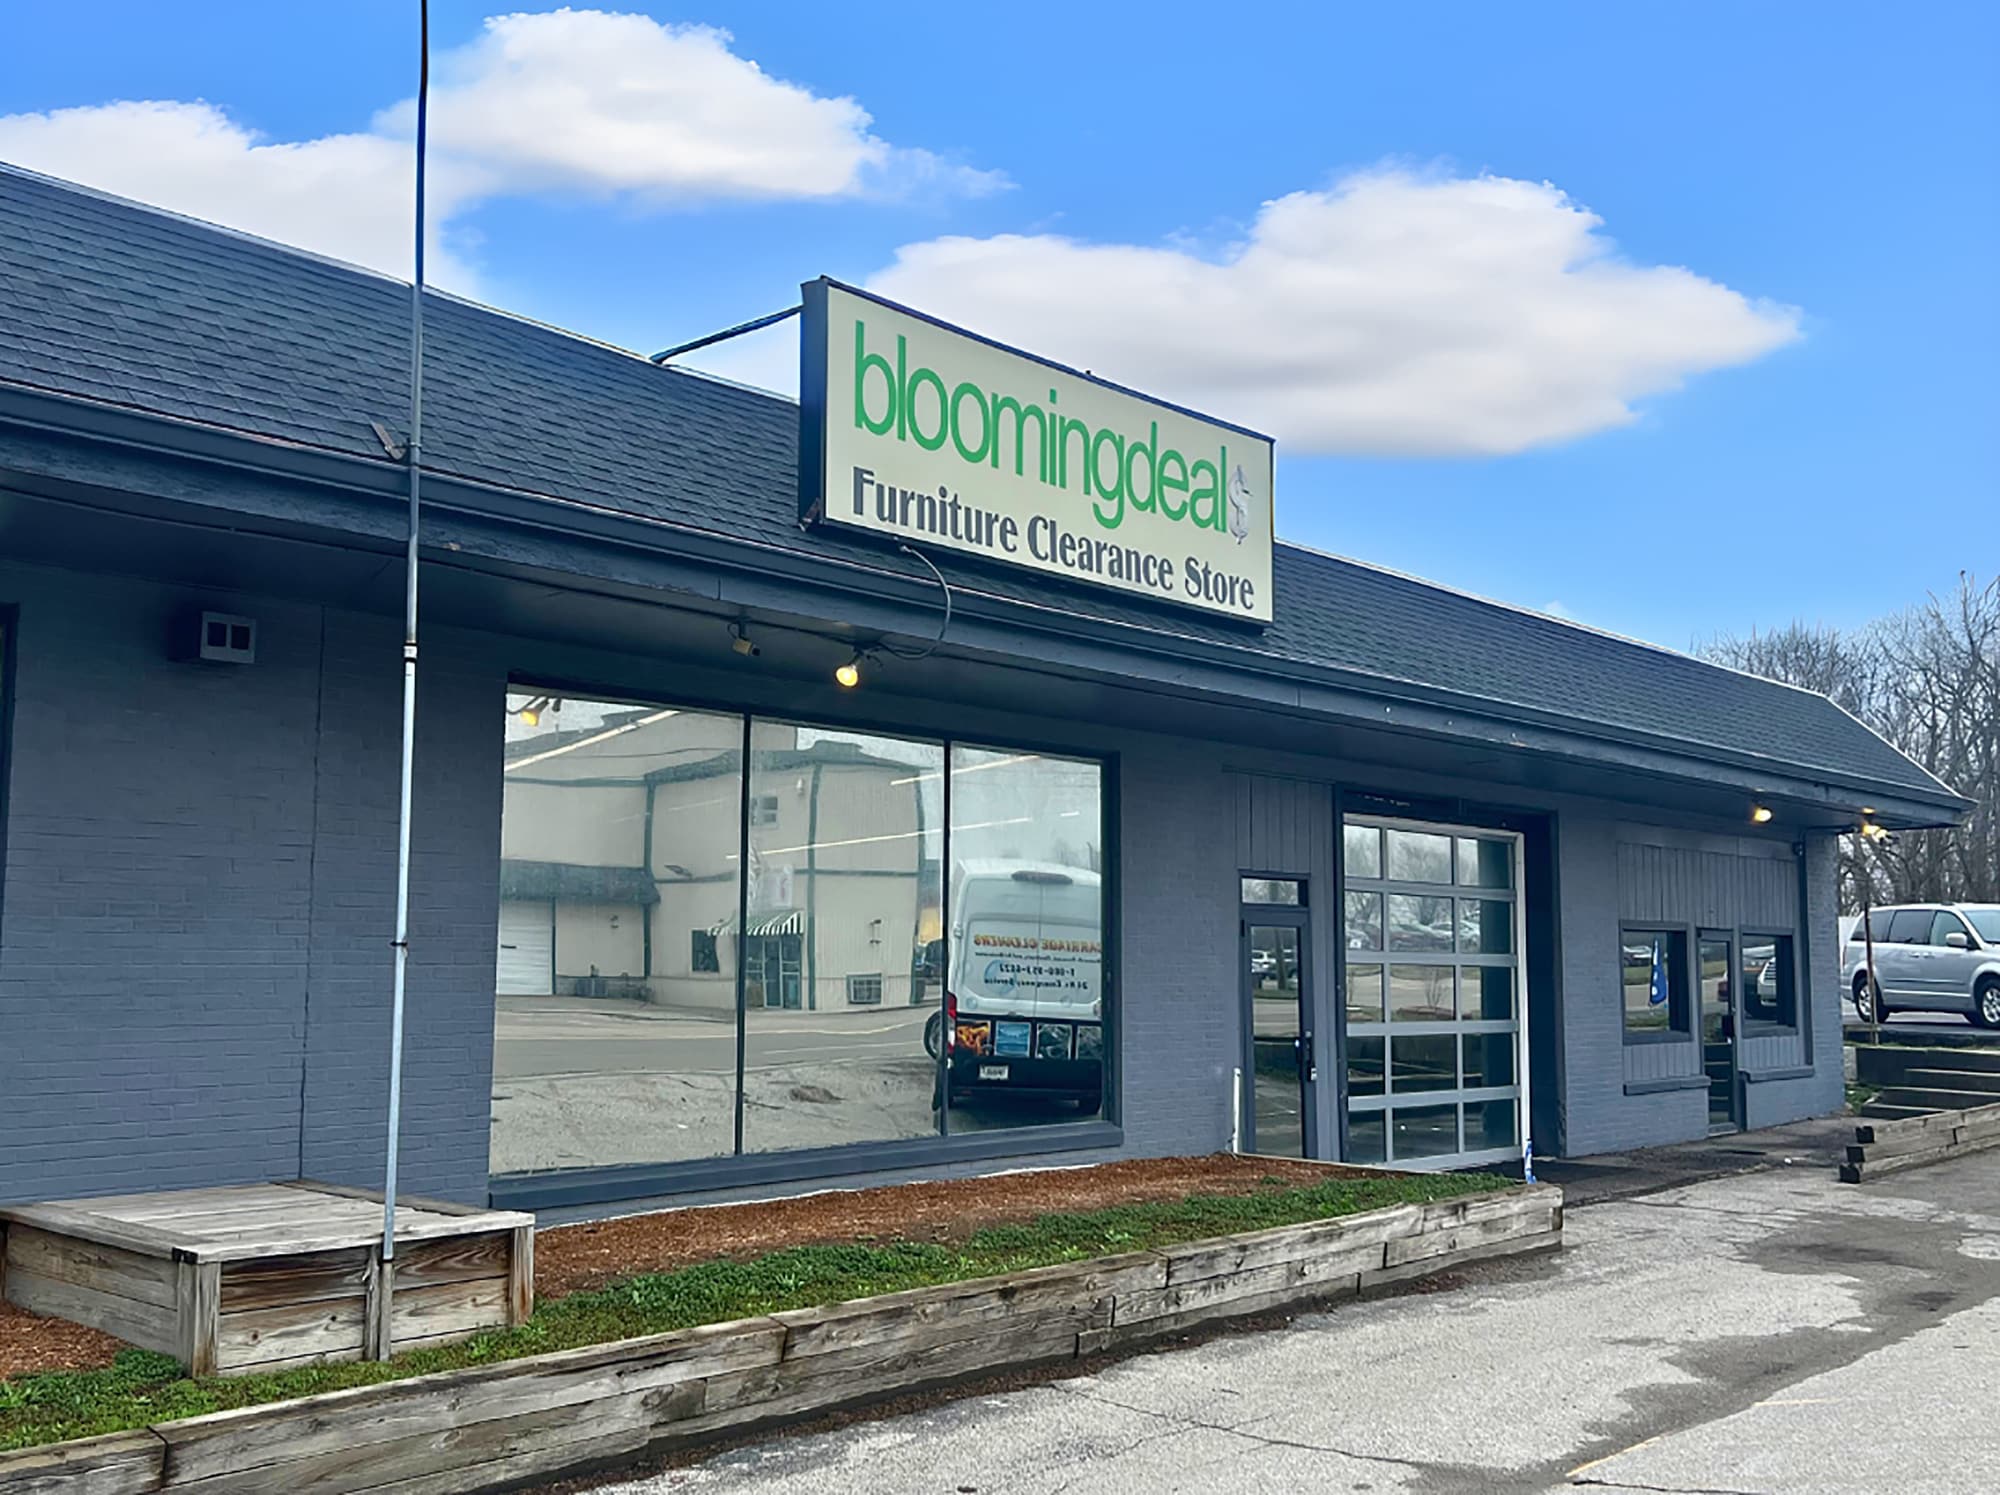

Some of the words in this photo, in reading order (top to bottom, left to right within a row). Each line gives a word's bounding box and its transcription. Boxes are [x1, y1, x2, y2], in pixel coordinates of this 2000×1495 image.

[853, 466, 1018, 553] Furniture
[1027, 514, 1175, 590] Clearance
[1184, 556, 1255, 610] Store
